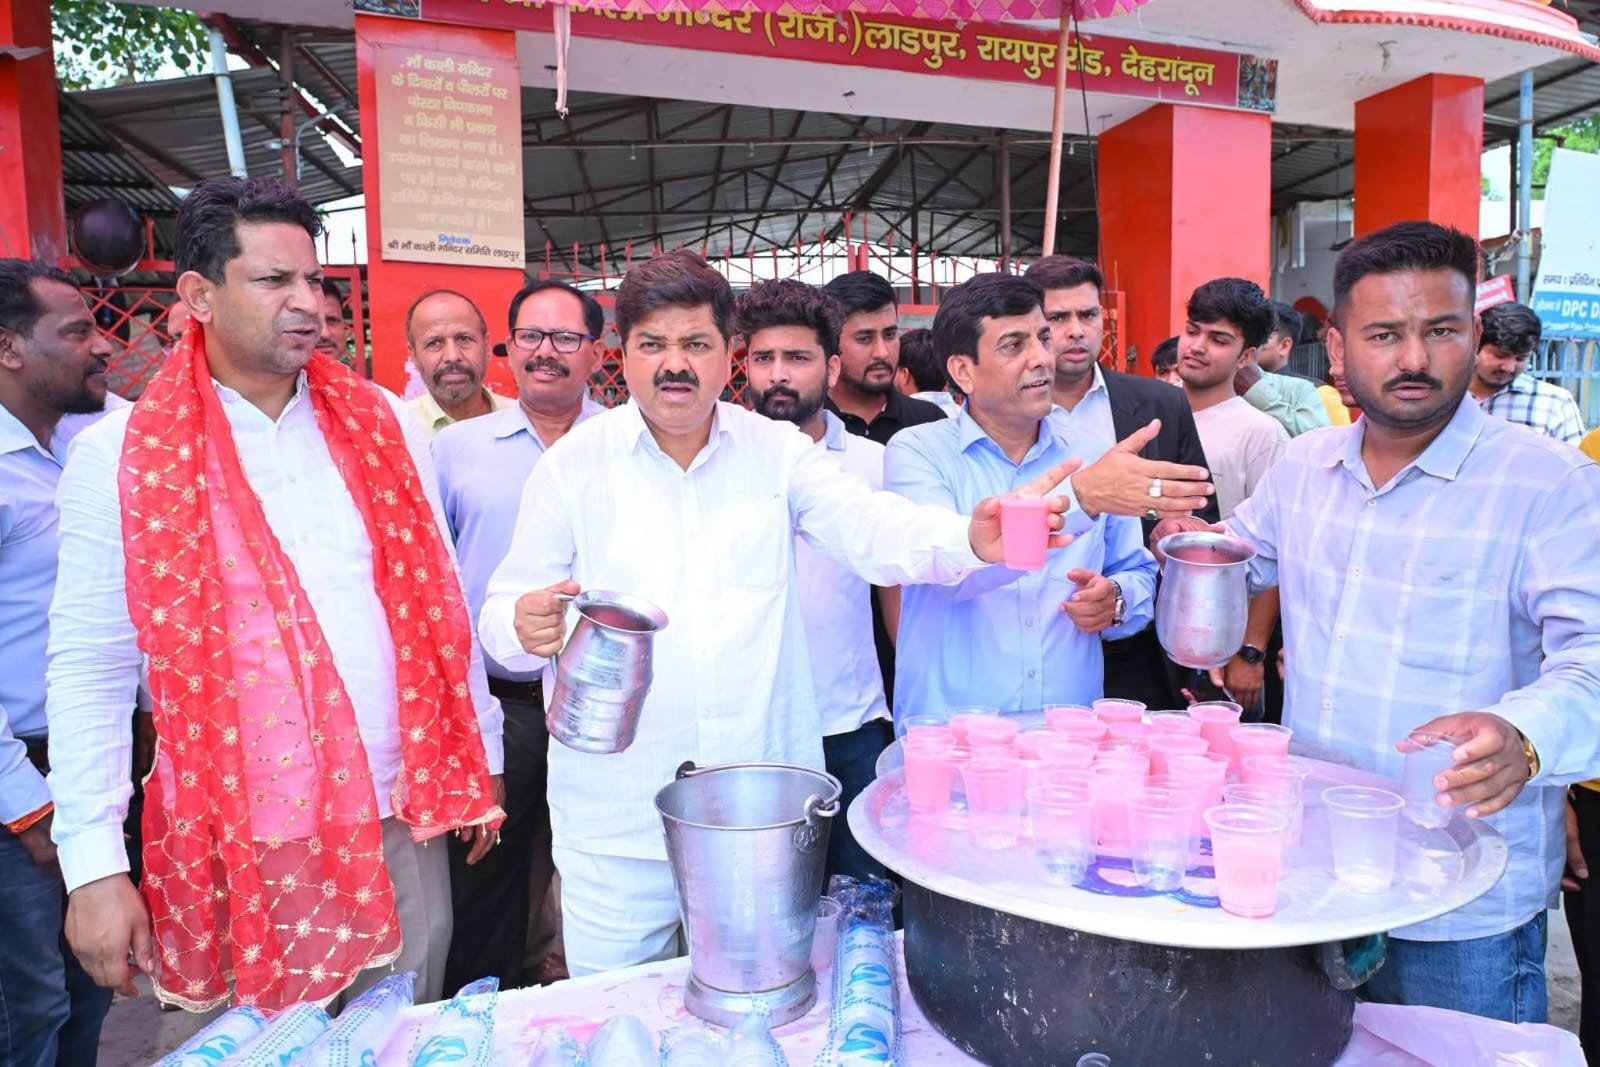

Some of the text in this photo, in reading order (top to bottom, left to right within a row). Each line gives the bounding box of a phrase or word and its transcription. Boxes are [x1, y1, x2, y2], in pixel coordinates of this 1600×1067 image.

[424, 57, 455, 73] काली
[457, 60, 493, 78] मन्दिर
[976, 34, 1057, 80] रायपुर
[1065, 37, 1112, 78] रोड,
[1120, 46, 1216, 96] देहरादून
[391, 72, 404, 87] के
[492, 87, 509, 100] पर
[407, 92, 493, 117] पोस्टर चिपकाना
[416, 112, 447, 129] किसी
[449, 116, 464, 131] भी
[466, 121, 497, 136] प्रकार
[387, 239, 400, 250] श्री
[413, 240, 436, 253] काली
[437, 242, 464, 255] मन्दिर
[464, 244, 491, 257] समिति
[492, 249, 520, 262] लाडपुर
[1561, 299, 1589, 318] DPC
